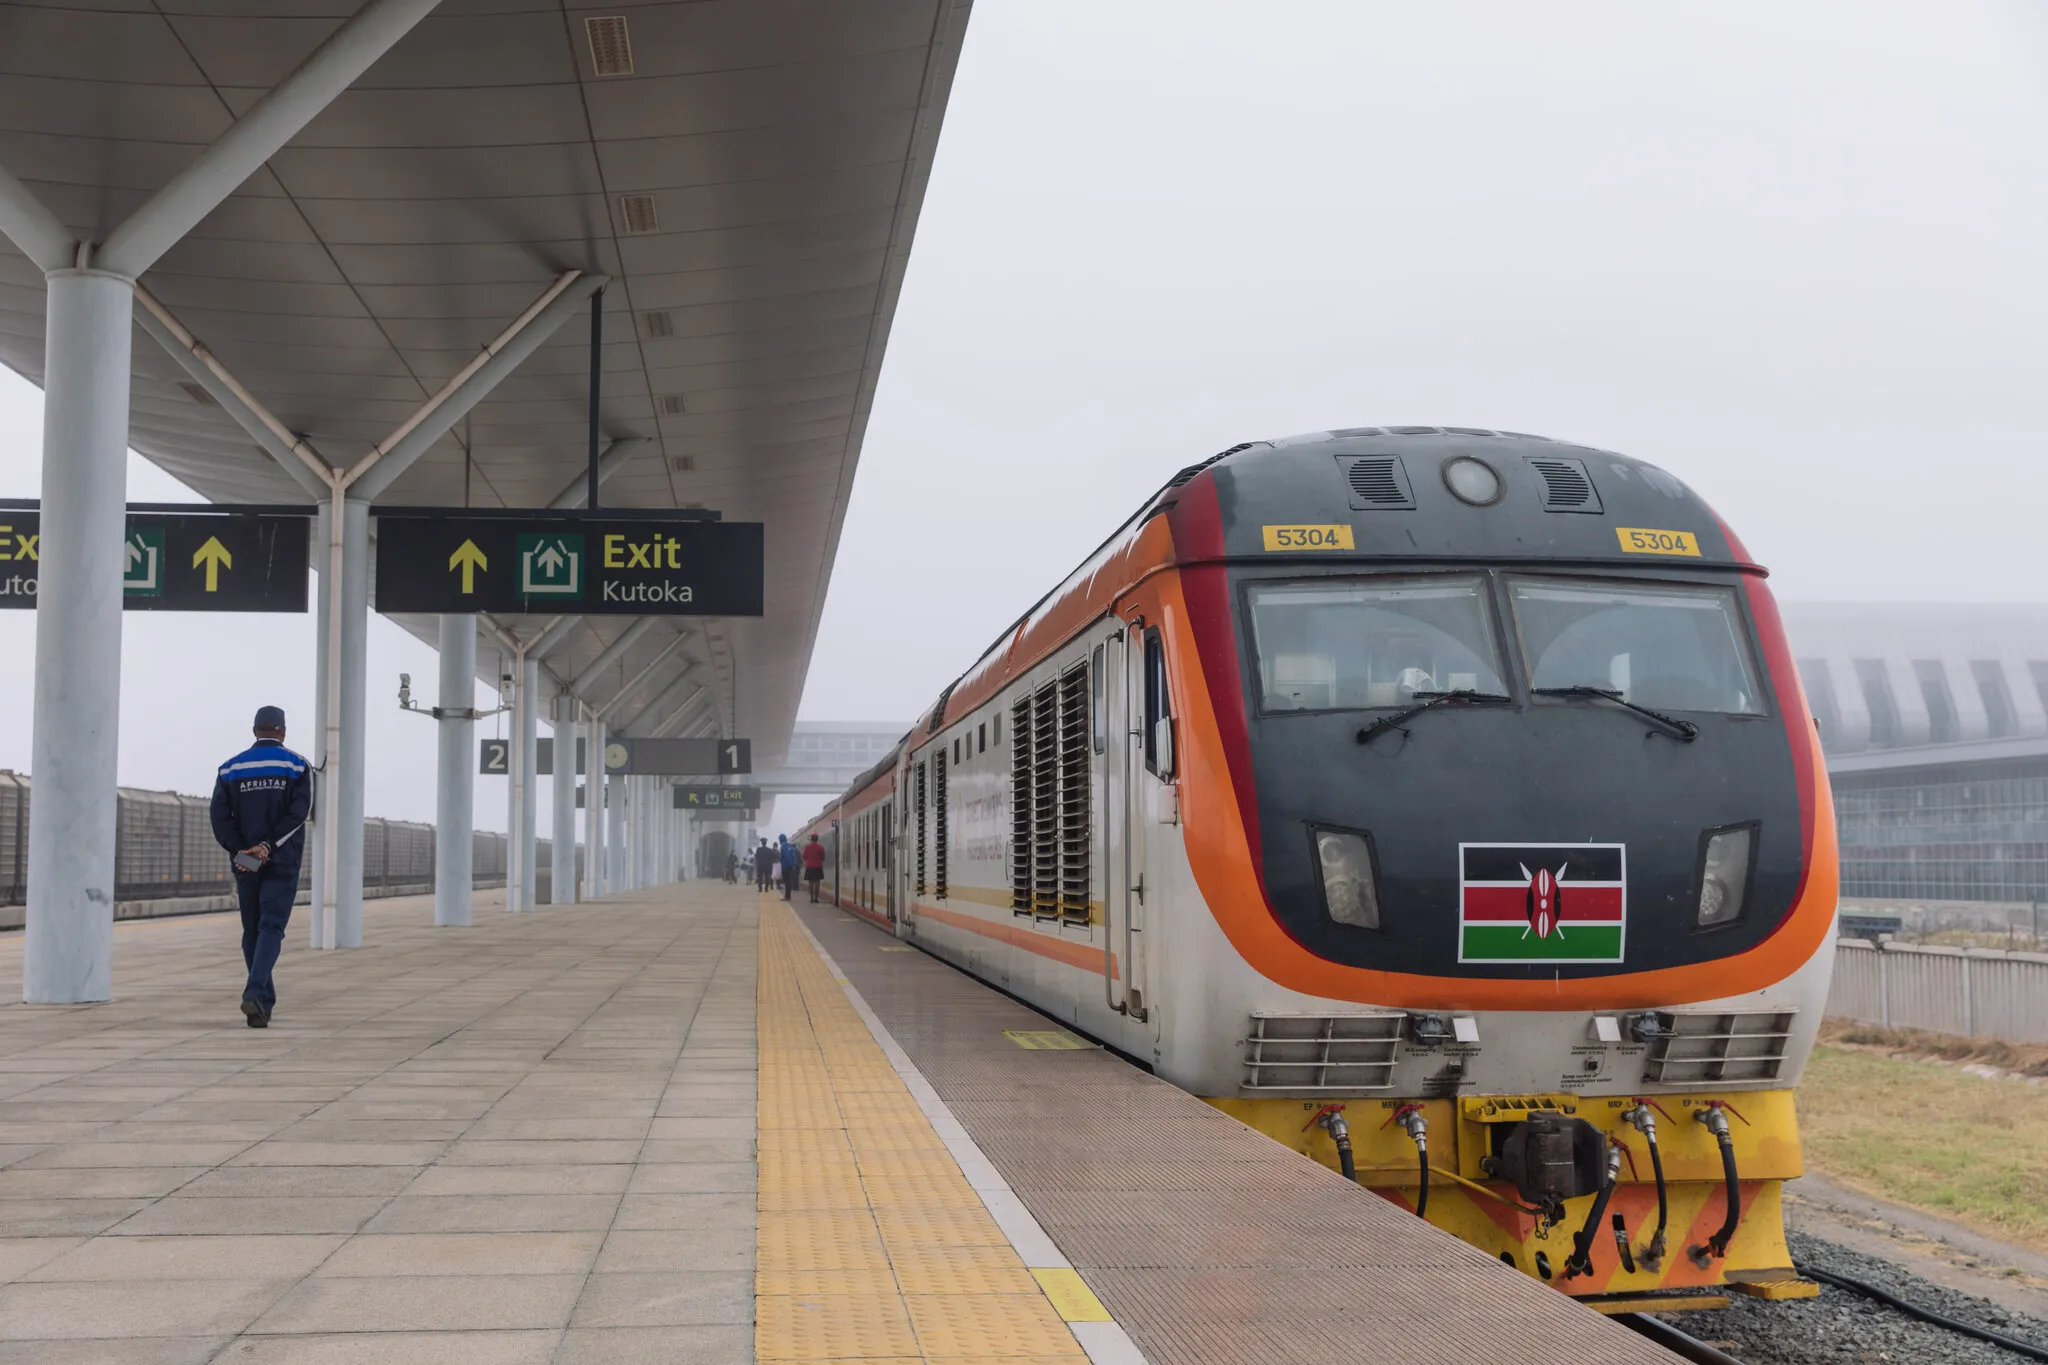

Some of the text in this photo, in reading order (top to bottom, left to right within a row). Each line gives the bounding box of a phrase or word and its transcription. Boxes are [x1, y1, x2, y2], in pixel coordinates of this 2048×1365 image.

[0, 525, 39, 560] Ex
[1276, 528, 1339, 547] 5304
[1630, 531, 1688, 552] 5304
[604, 533, 681, 569] Exit
[0, 575, 38, 595] uto
[603, 580, 693, 602] Kutoka
[488, 744, 505, 769] 2
[725, 745, 738, 769] 1
[240, 778, 287, 789] AFRISTAR
[723, 790, 742, 799] Exit
